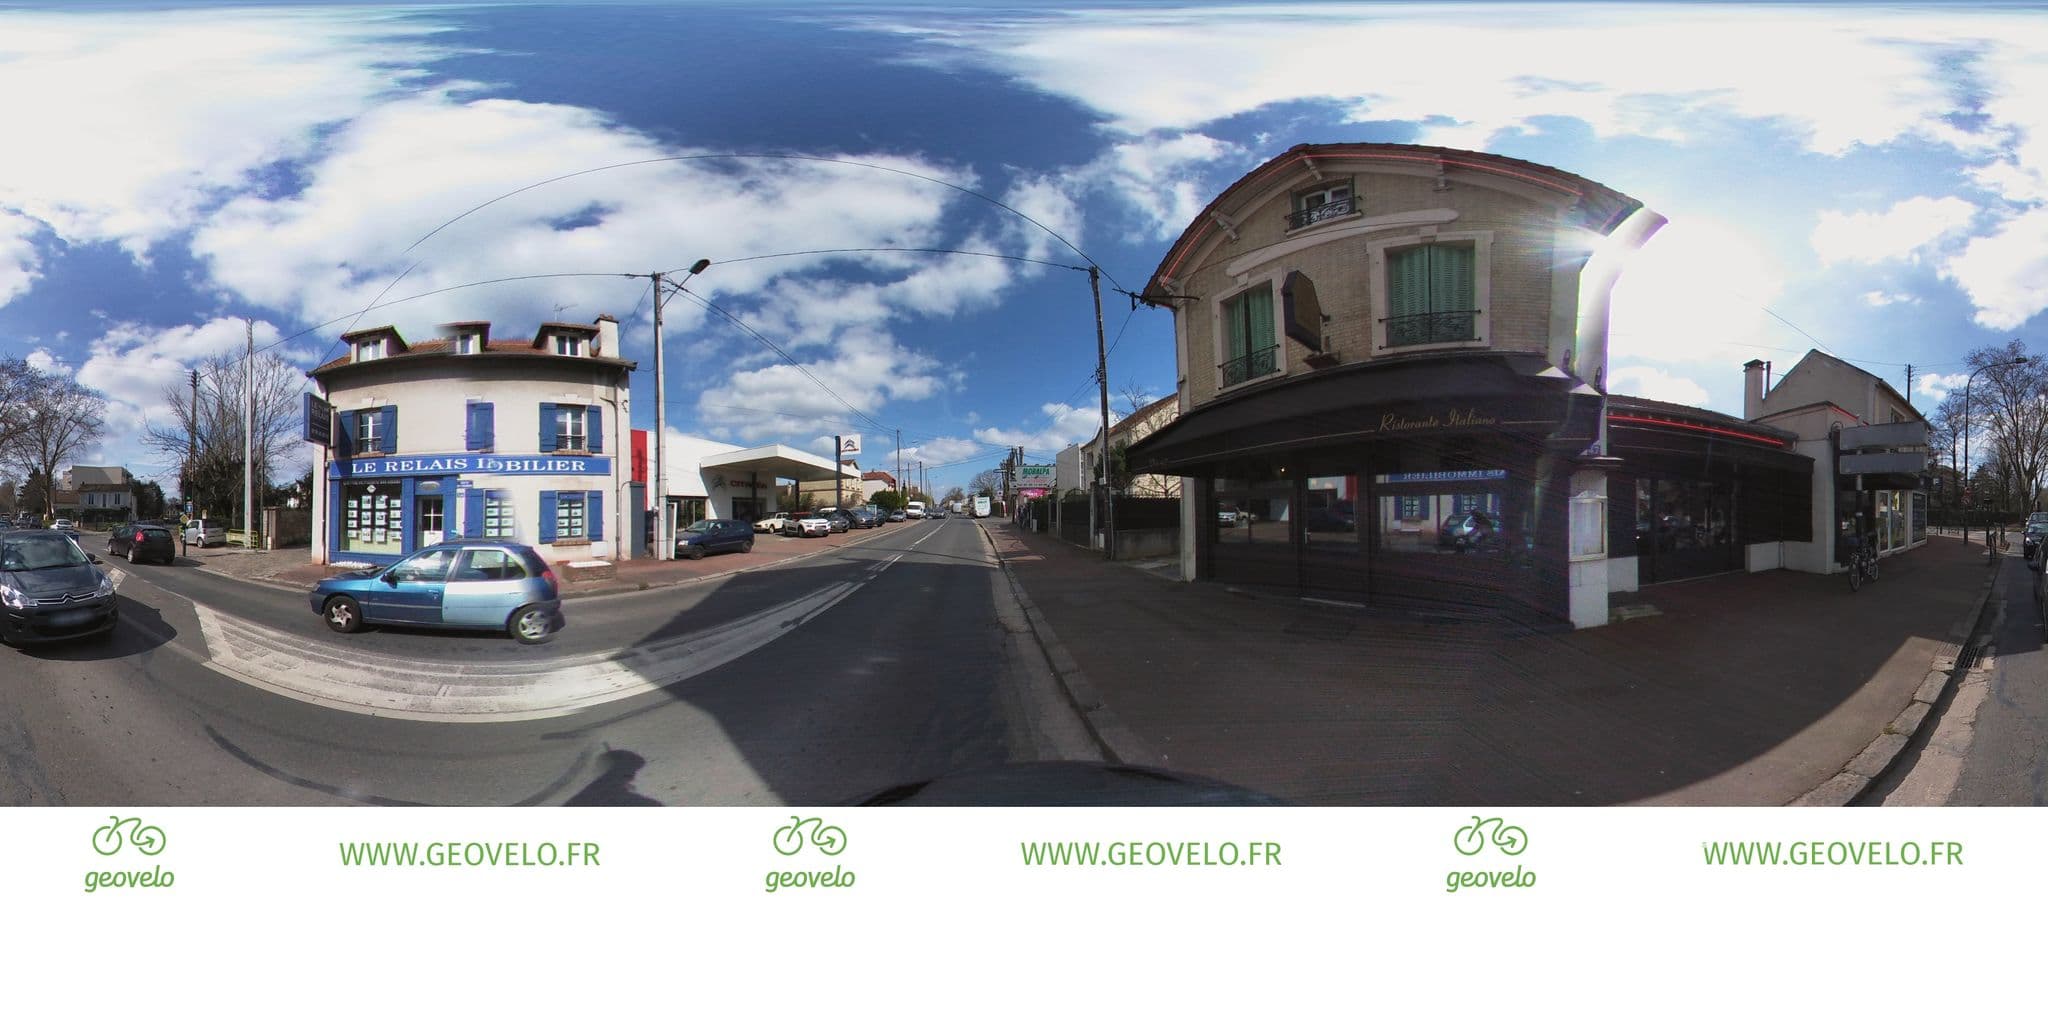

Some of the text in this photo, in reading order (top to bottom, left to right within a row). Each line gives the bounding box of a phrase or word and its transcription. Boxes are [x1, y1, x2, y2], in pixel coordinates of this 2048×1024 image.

[1379, 407, 1496, 432] Ristorante Italiano
[351, 462, 376, 474] LE
[384, 459, 468, 472] RELAIS
